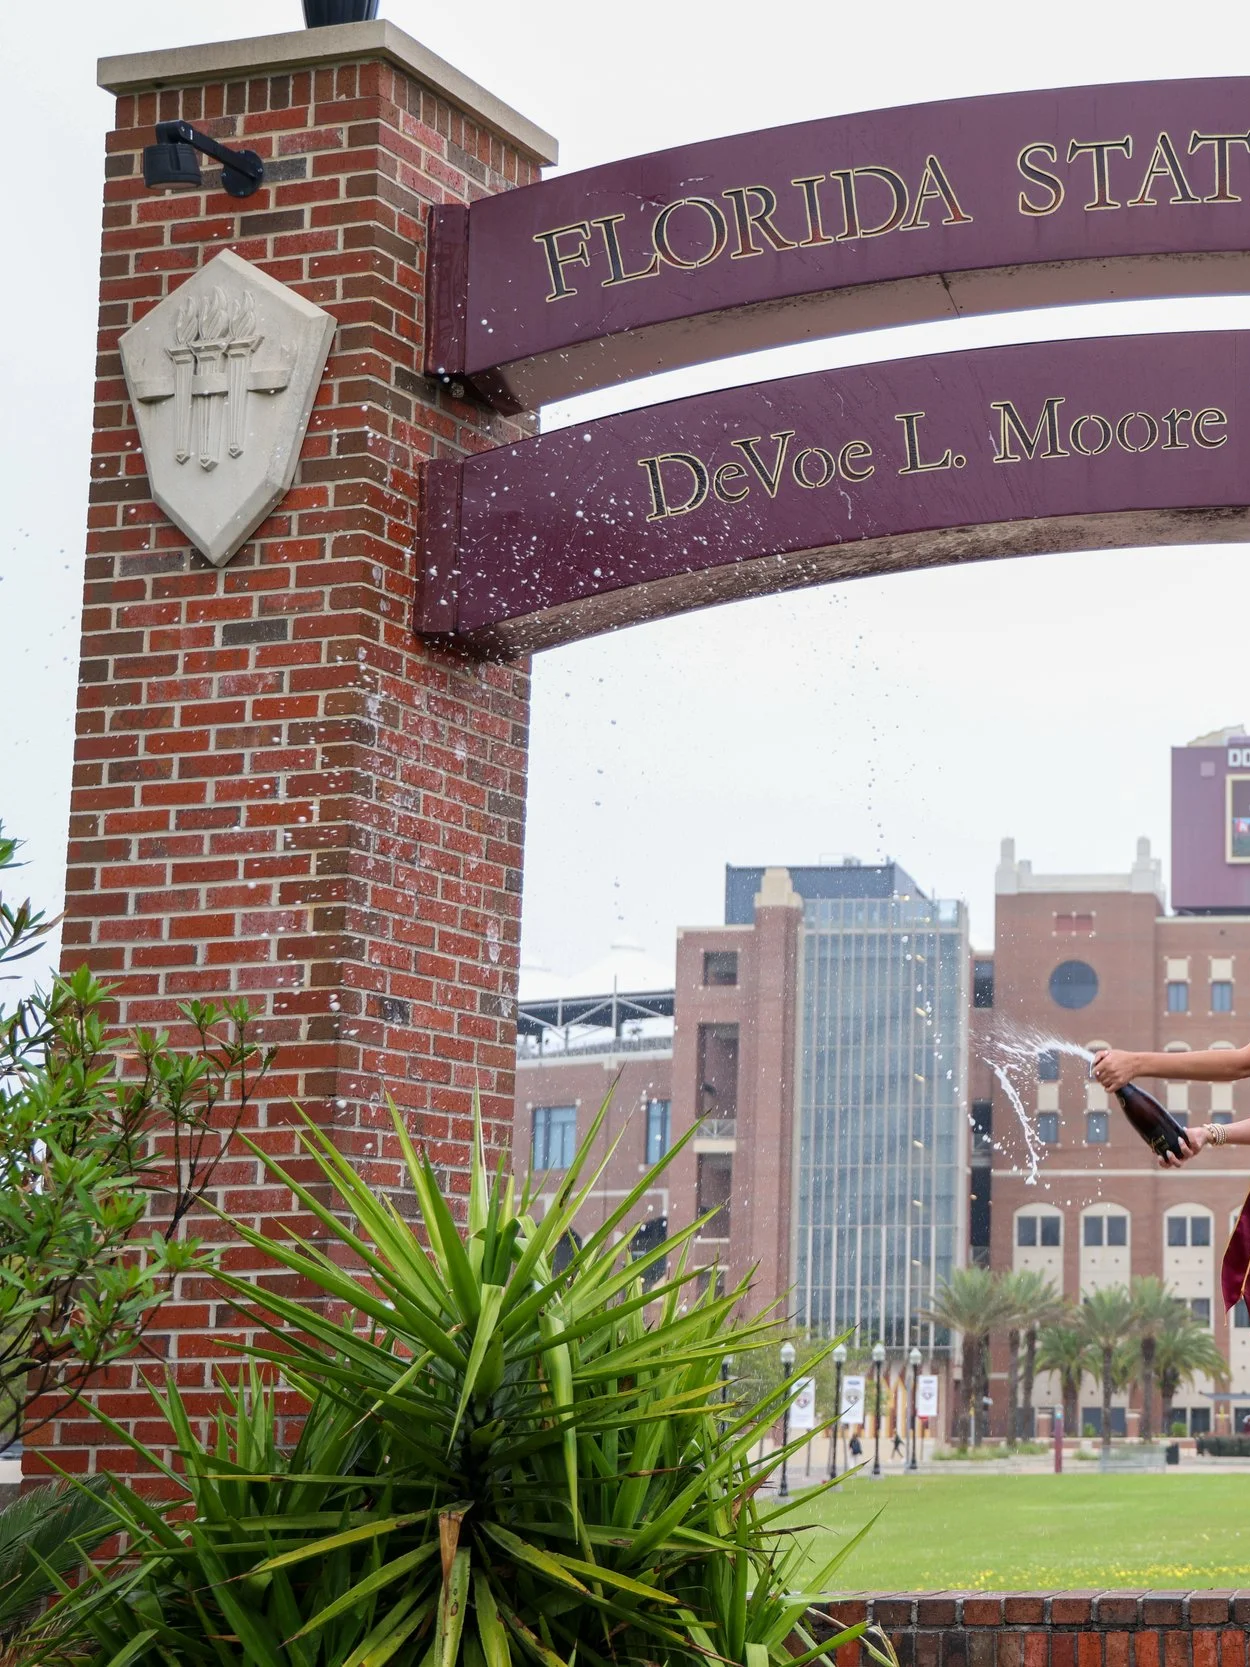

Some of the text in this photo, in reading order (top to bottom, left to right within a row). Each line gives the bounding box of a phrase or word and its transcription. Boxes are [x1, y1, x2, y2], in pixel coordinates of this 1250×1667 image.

[533, 154, 973, 302] FLORIDA
[638, 431, 874, 522] DeVoe
[895, 412, 966, 475] L.
[990, 397, 1227, 463] Moore
